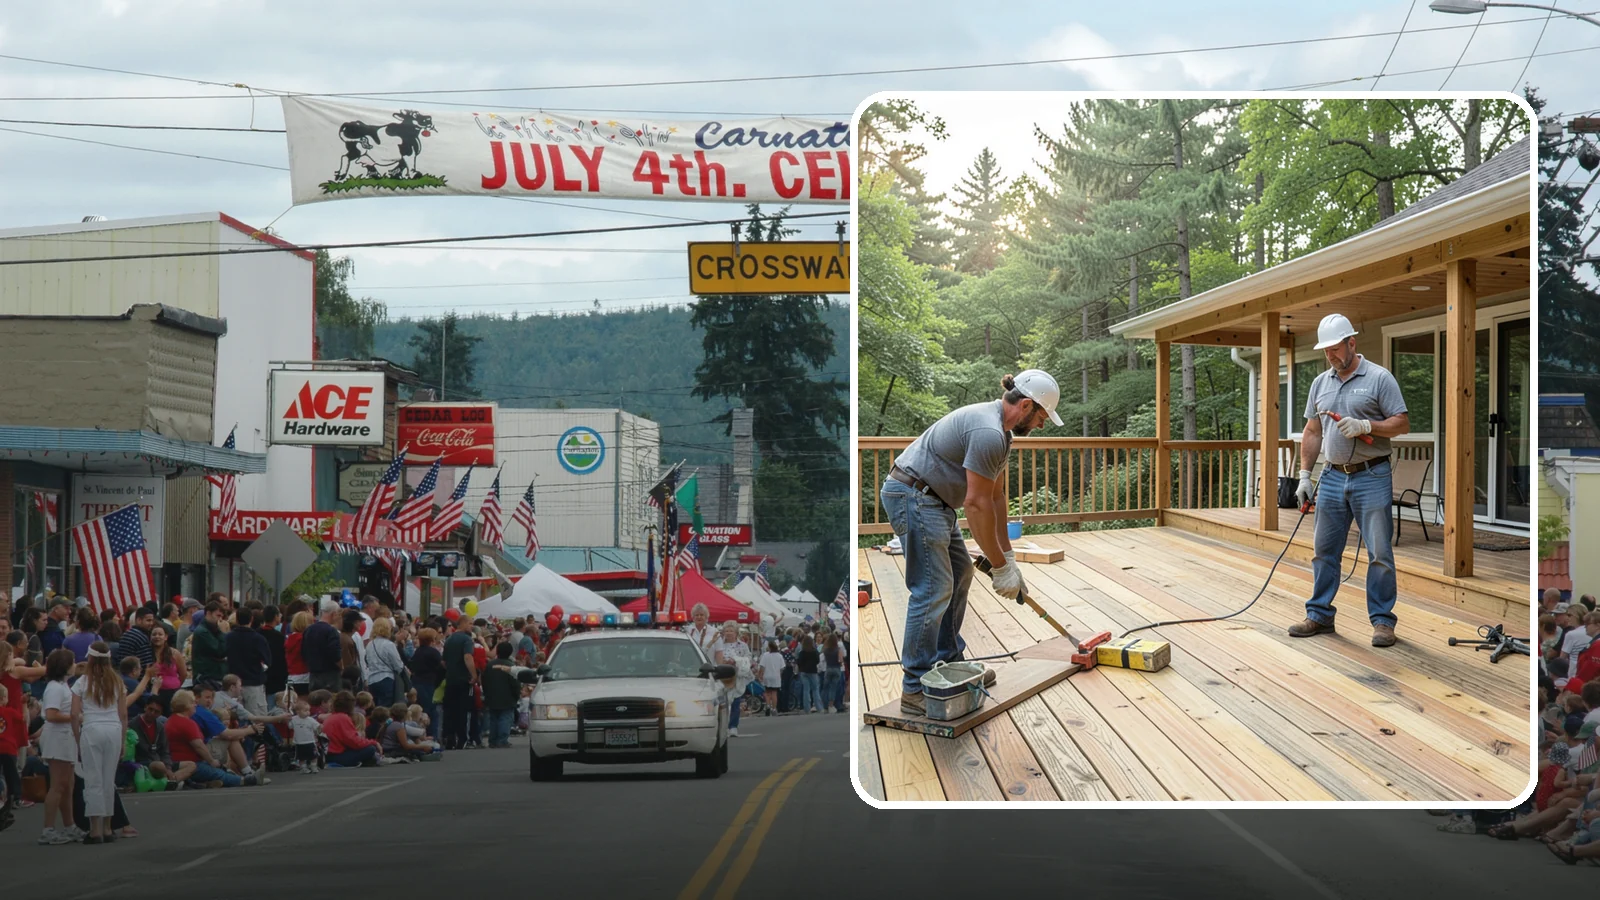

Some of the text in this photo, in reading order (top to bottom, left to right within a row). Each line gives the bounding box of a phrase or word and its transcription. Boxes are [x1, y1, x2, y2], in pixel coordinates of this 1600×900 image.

[481, 140, 605, 192] JULY
[632, 150, 747, 198] 4th.
[697, 254, 850, 280] CROSSWA
[282, 380, 373, 420] ACE
[406, 409, 452, 422] CEDAR
[283, 421, 371, 437] Hardware
[95, 485, 124, 495] Vincent
[126, 486, 136, 495] de
[137, 486, 155, 496] Paul
[81, 503, 154, 522] THT
[212, 516, 331, 535] HARDARE
[688, 526, 741, 535] CRNATION
[699, 535, 730, 544] GLASS
